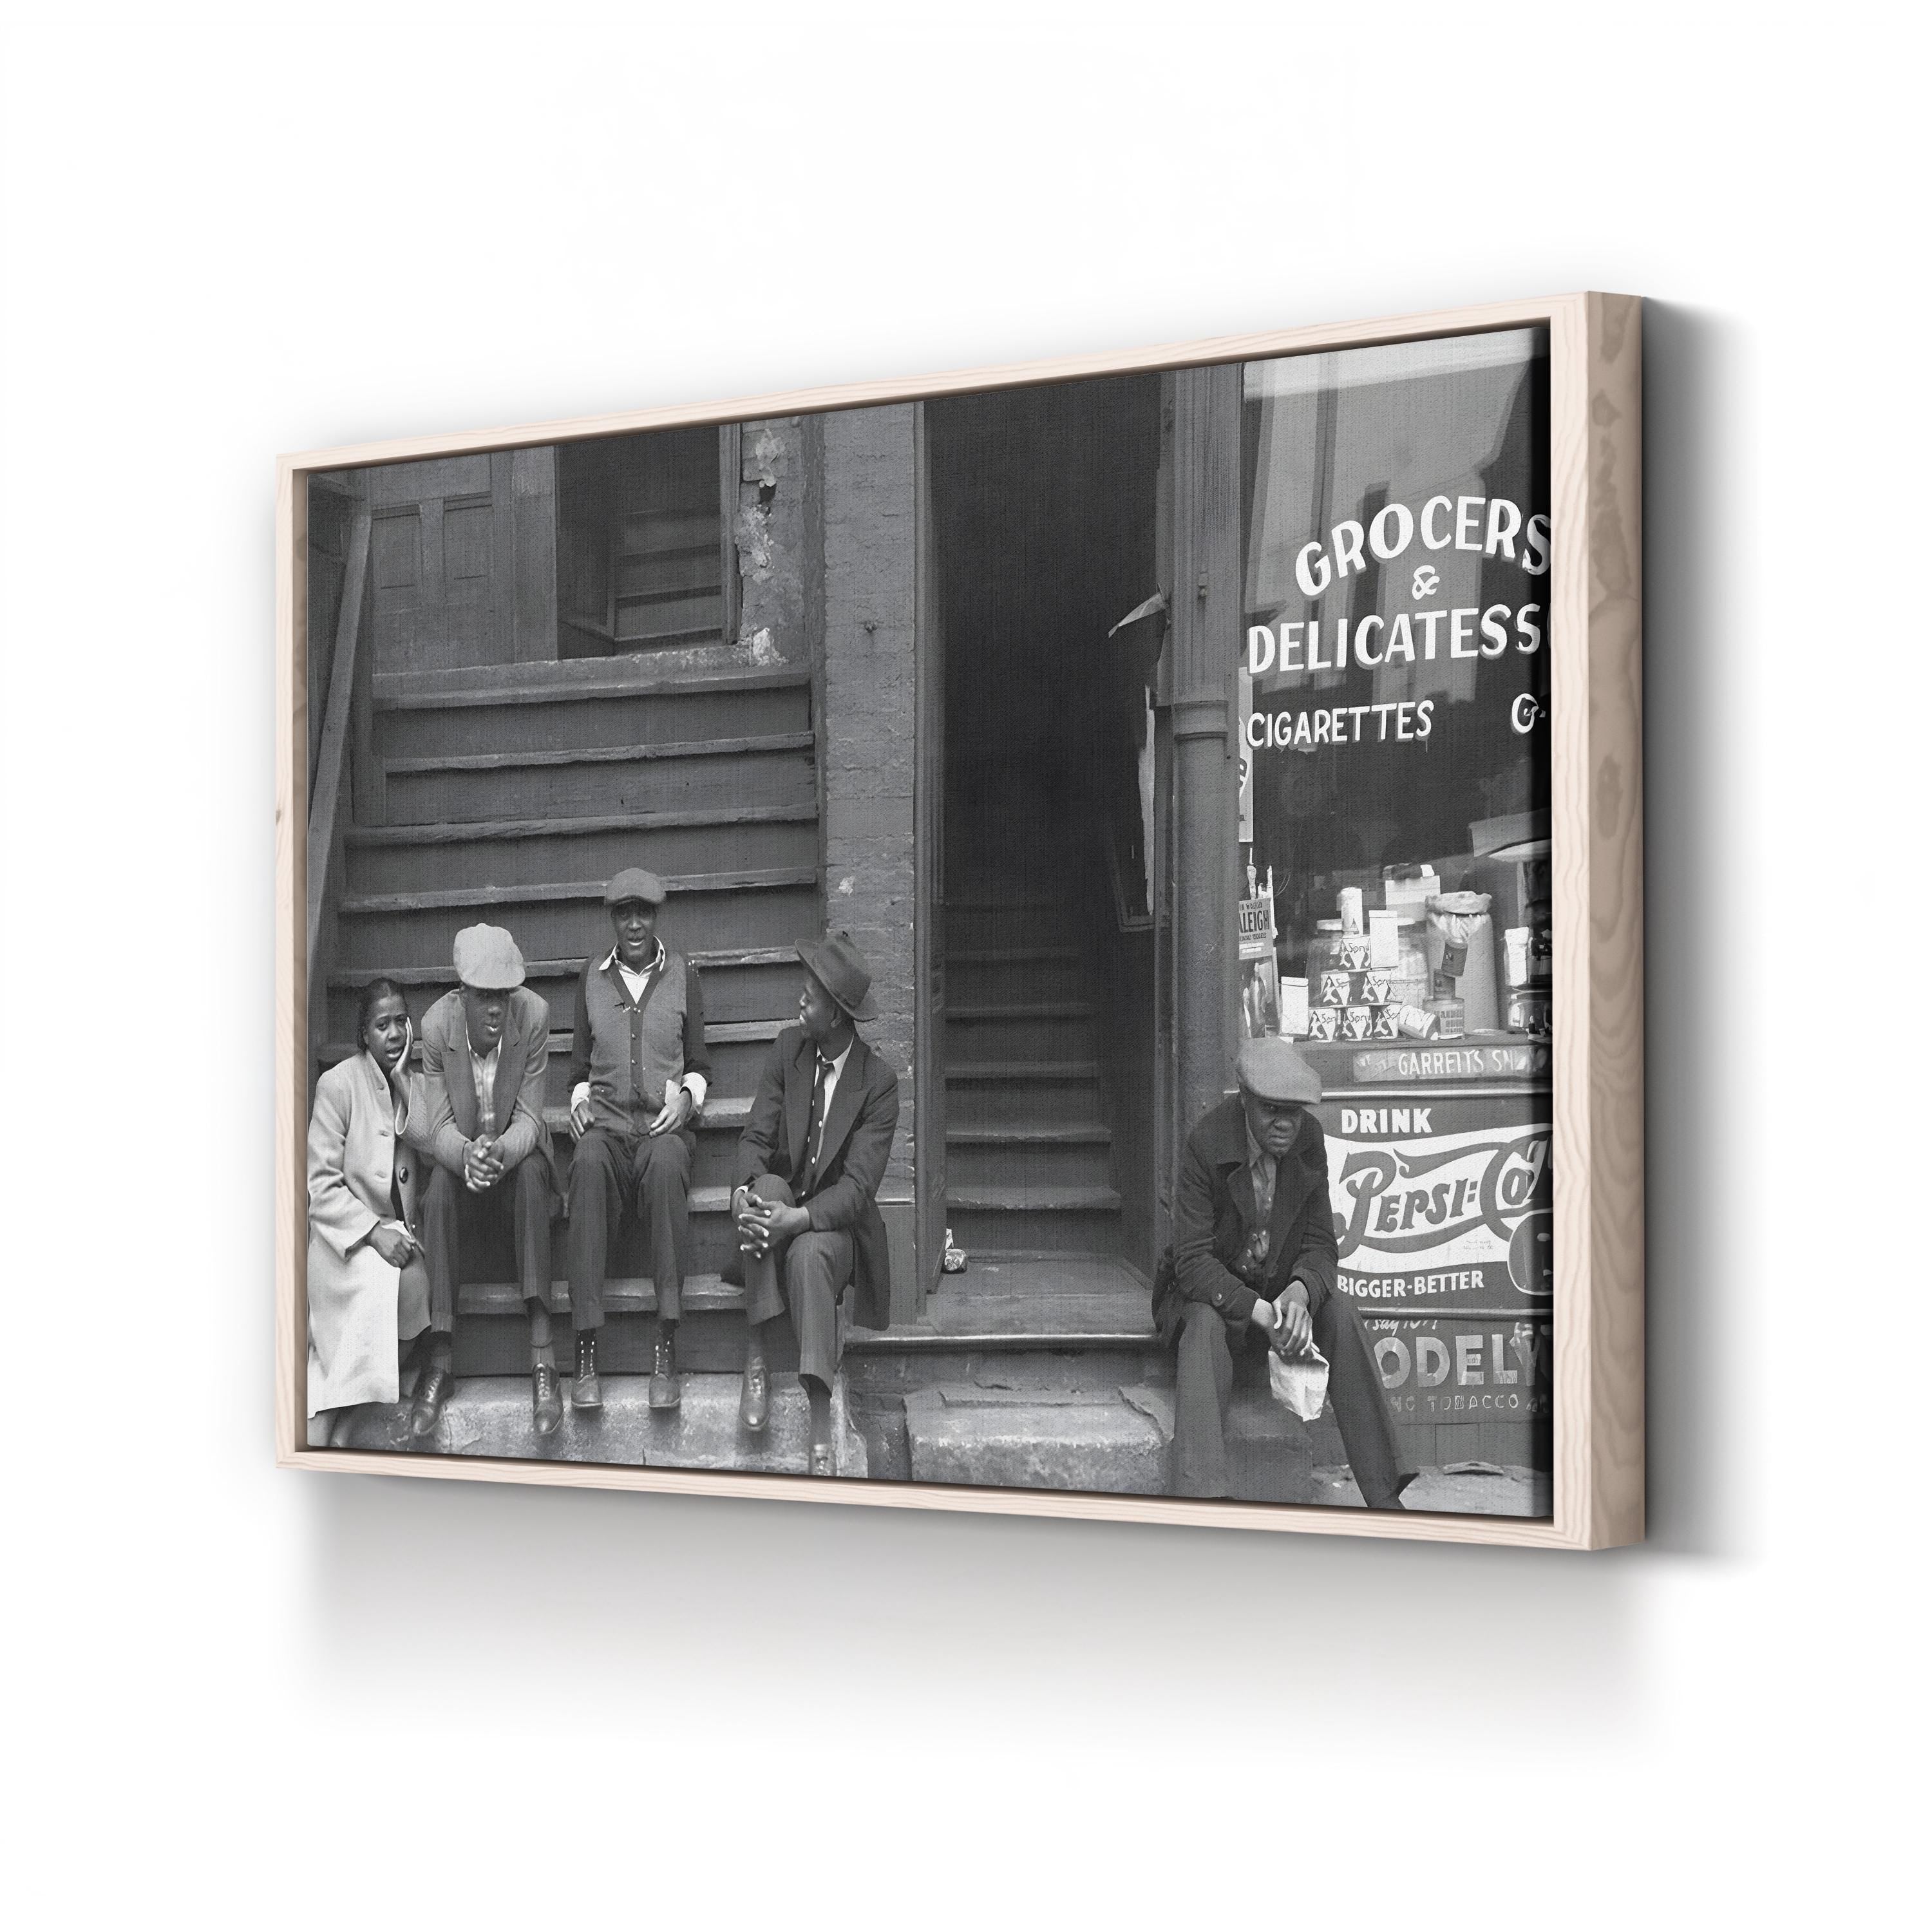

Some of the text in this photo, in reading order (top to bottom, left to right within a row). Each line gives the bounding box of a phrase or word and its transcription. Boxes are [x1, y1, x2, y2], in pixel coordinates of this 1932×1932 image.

[1295, 495, 1551, 596] GROCERS
[1411, 564, 1441, 600] &
[1247, 603, 1551, 675] DELICATESS
[1246, 699, 1435, 748] CIGARETTES
[1341, 1108, 1433, 1134] DRINK
[1336, 1270, 1484, 1298] BIGGER-BETTER
